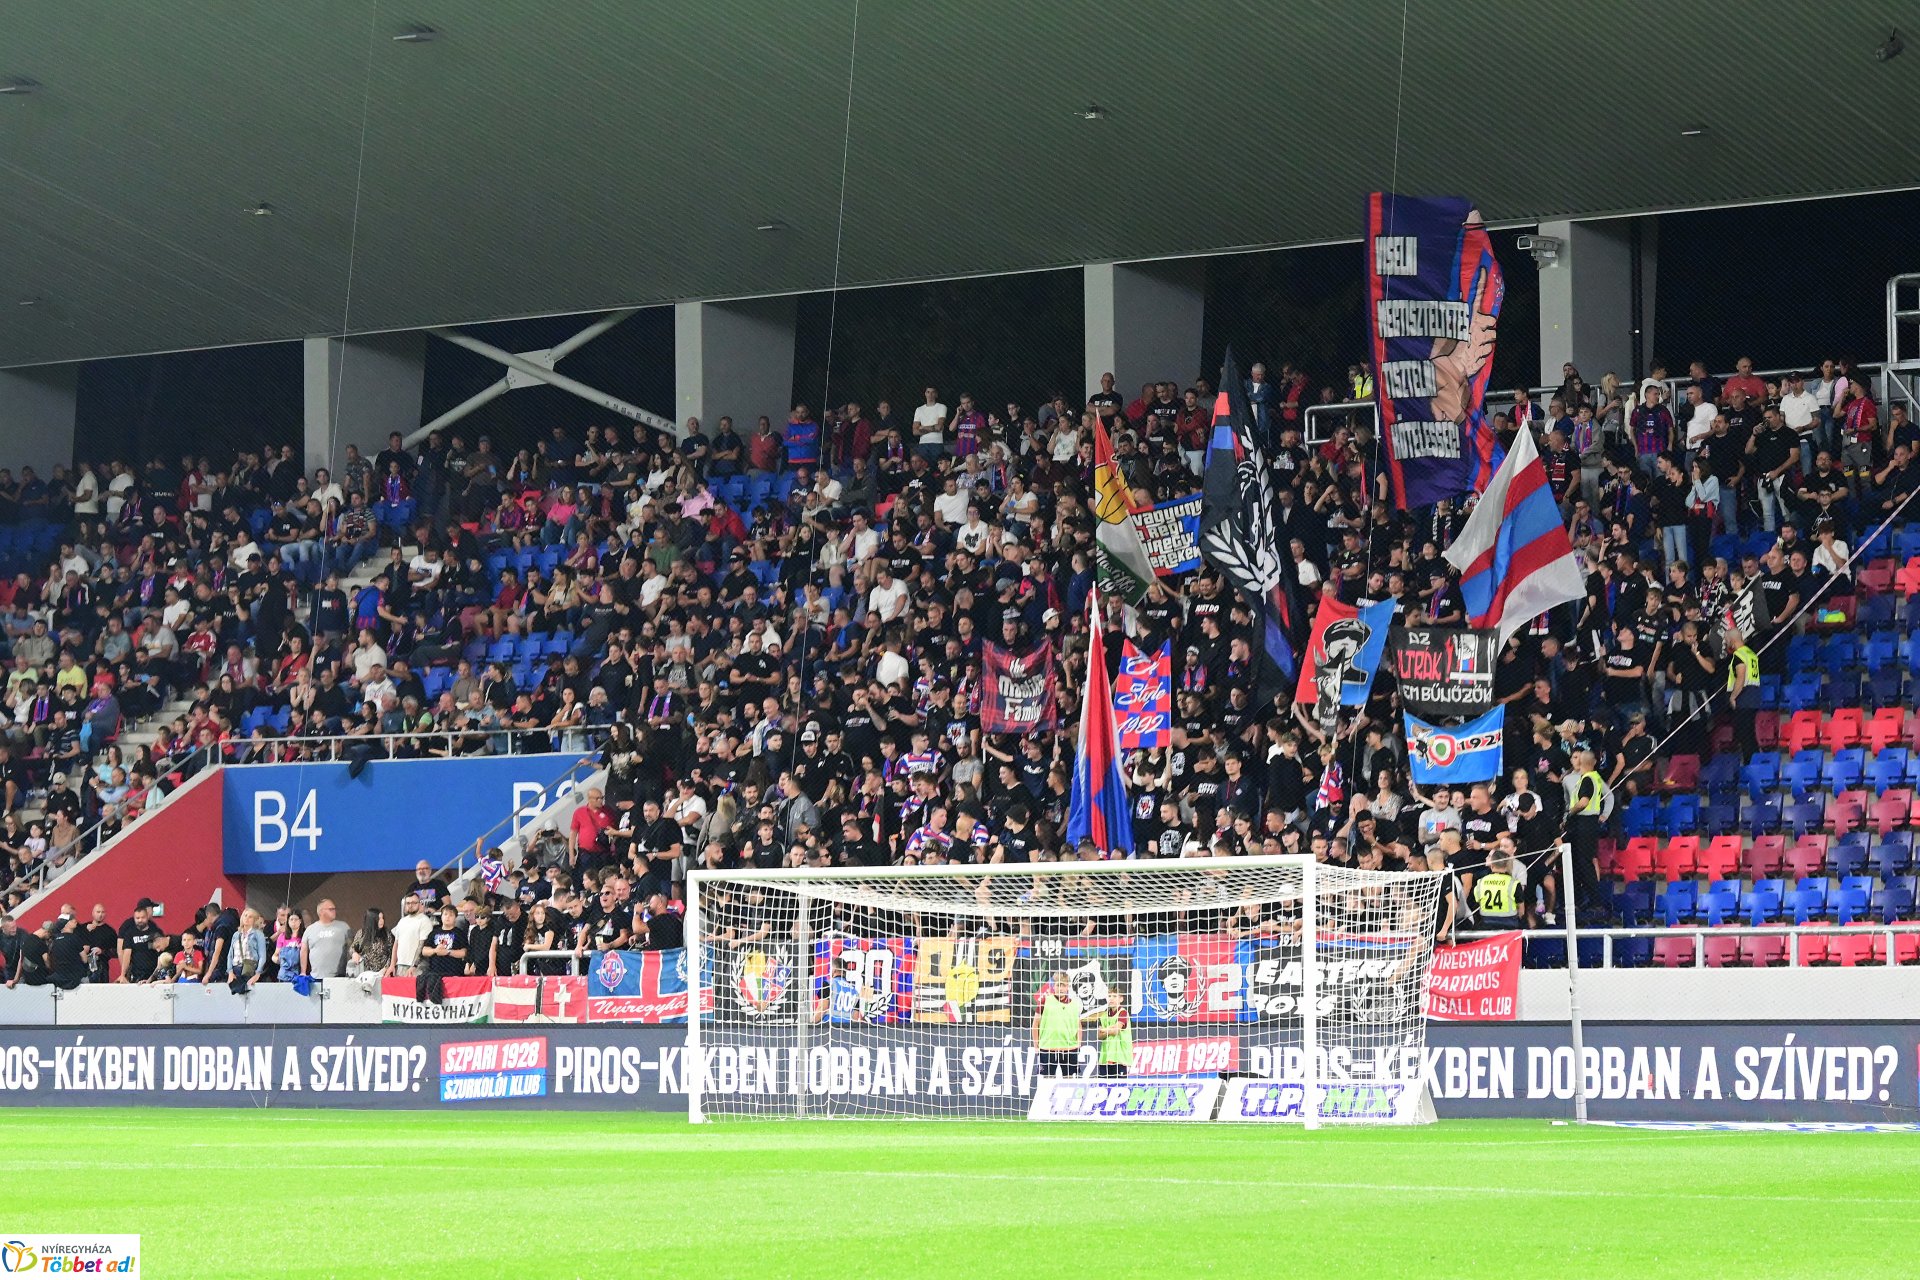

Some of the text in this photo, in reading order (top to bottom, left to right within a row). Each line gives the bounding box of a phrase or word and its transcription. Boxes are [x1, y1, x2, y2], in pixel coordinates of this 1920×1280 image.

[1401, 684, 1420, 701] EM
[1457, 733, 1501, 751] 192
[254, 788, 323, 852] B4
[1484, 889, 1503, 910] 24
[1034, 939, 1063, 957] 1928
[1431, 944, 1509, 970] YÍREGYHÁZA
[594, 994, 709, 1017] Nyíregyháa
[1480, 996, 1513, 1016] CLUB
[163, 1046, 273, 1091] DOBBAN
[281, 1046, 302, 1091] A
[310, 1034, 427, 1092] SZÍVED?
[445, 1041, 540, 1073] SZPARI 1928
[1129, 1040, 1232, 1074] ZPARI 1928
[1527, 1046, 1682, 1100] DOBBAN
[1694, 1046, 1723, 1100] A
[1735, 1032, 1899, 1101] SZÍVED?
[927, 1046, 952, 1096] A
[510, 1075, 541, 1096] KLUB
